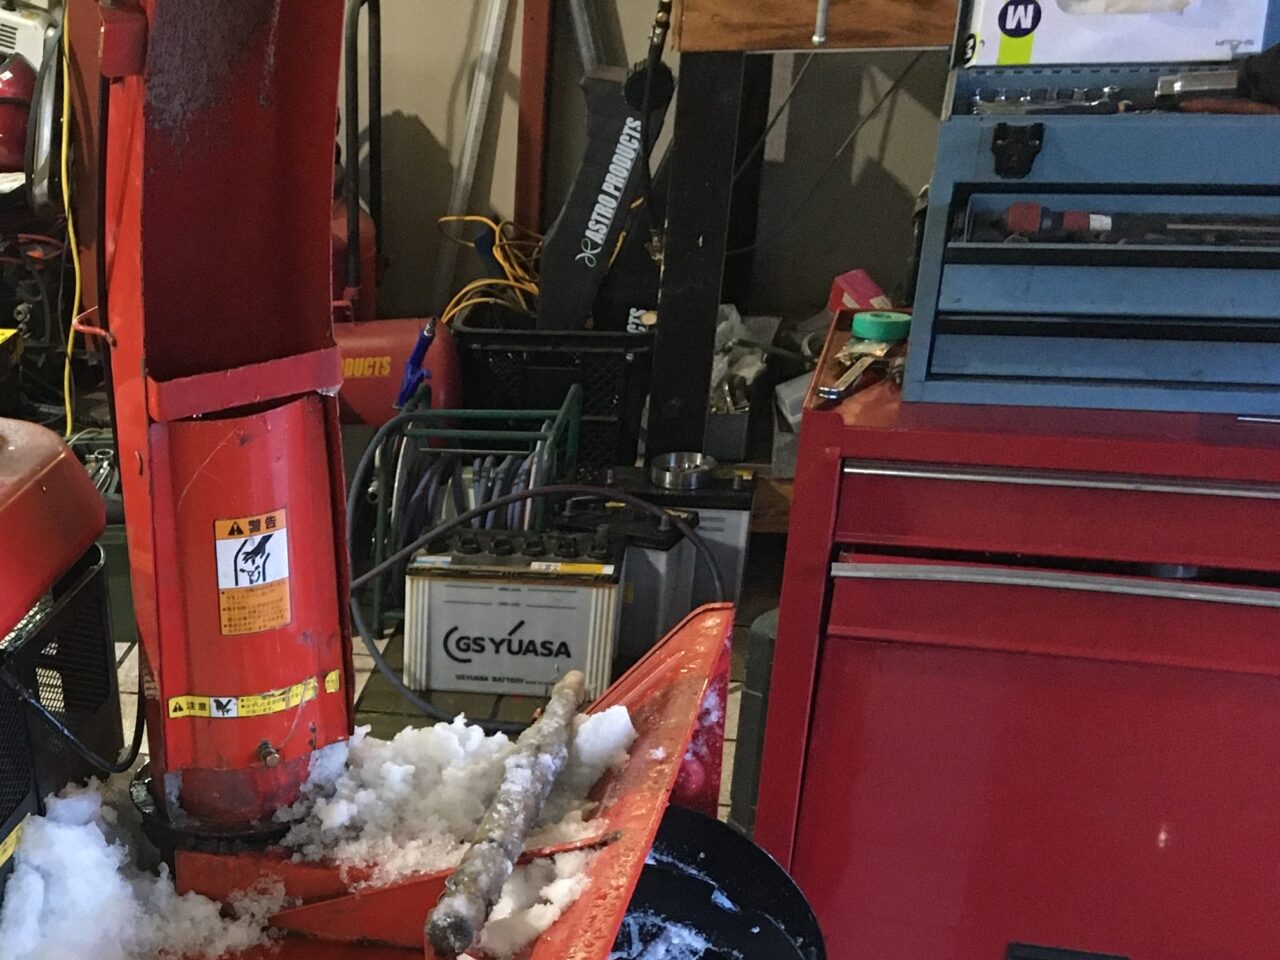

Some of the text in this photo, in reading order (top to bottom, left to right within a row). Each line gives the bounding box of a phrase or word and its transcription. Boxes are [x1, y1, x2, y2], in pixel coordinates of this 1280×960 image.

[585, 116, 642, 244] ASTRO PRODUCTS
[344, 356, 391, 378] DUCTS
[247, 515, 277, 534] 警告
[489, 621, 572, 659] YUASA
[186, 701, 208, 711] 注意
